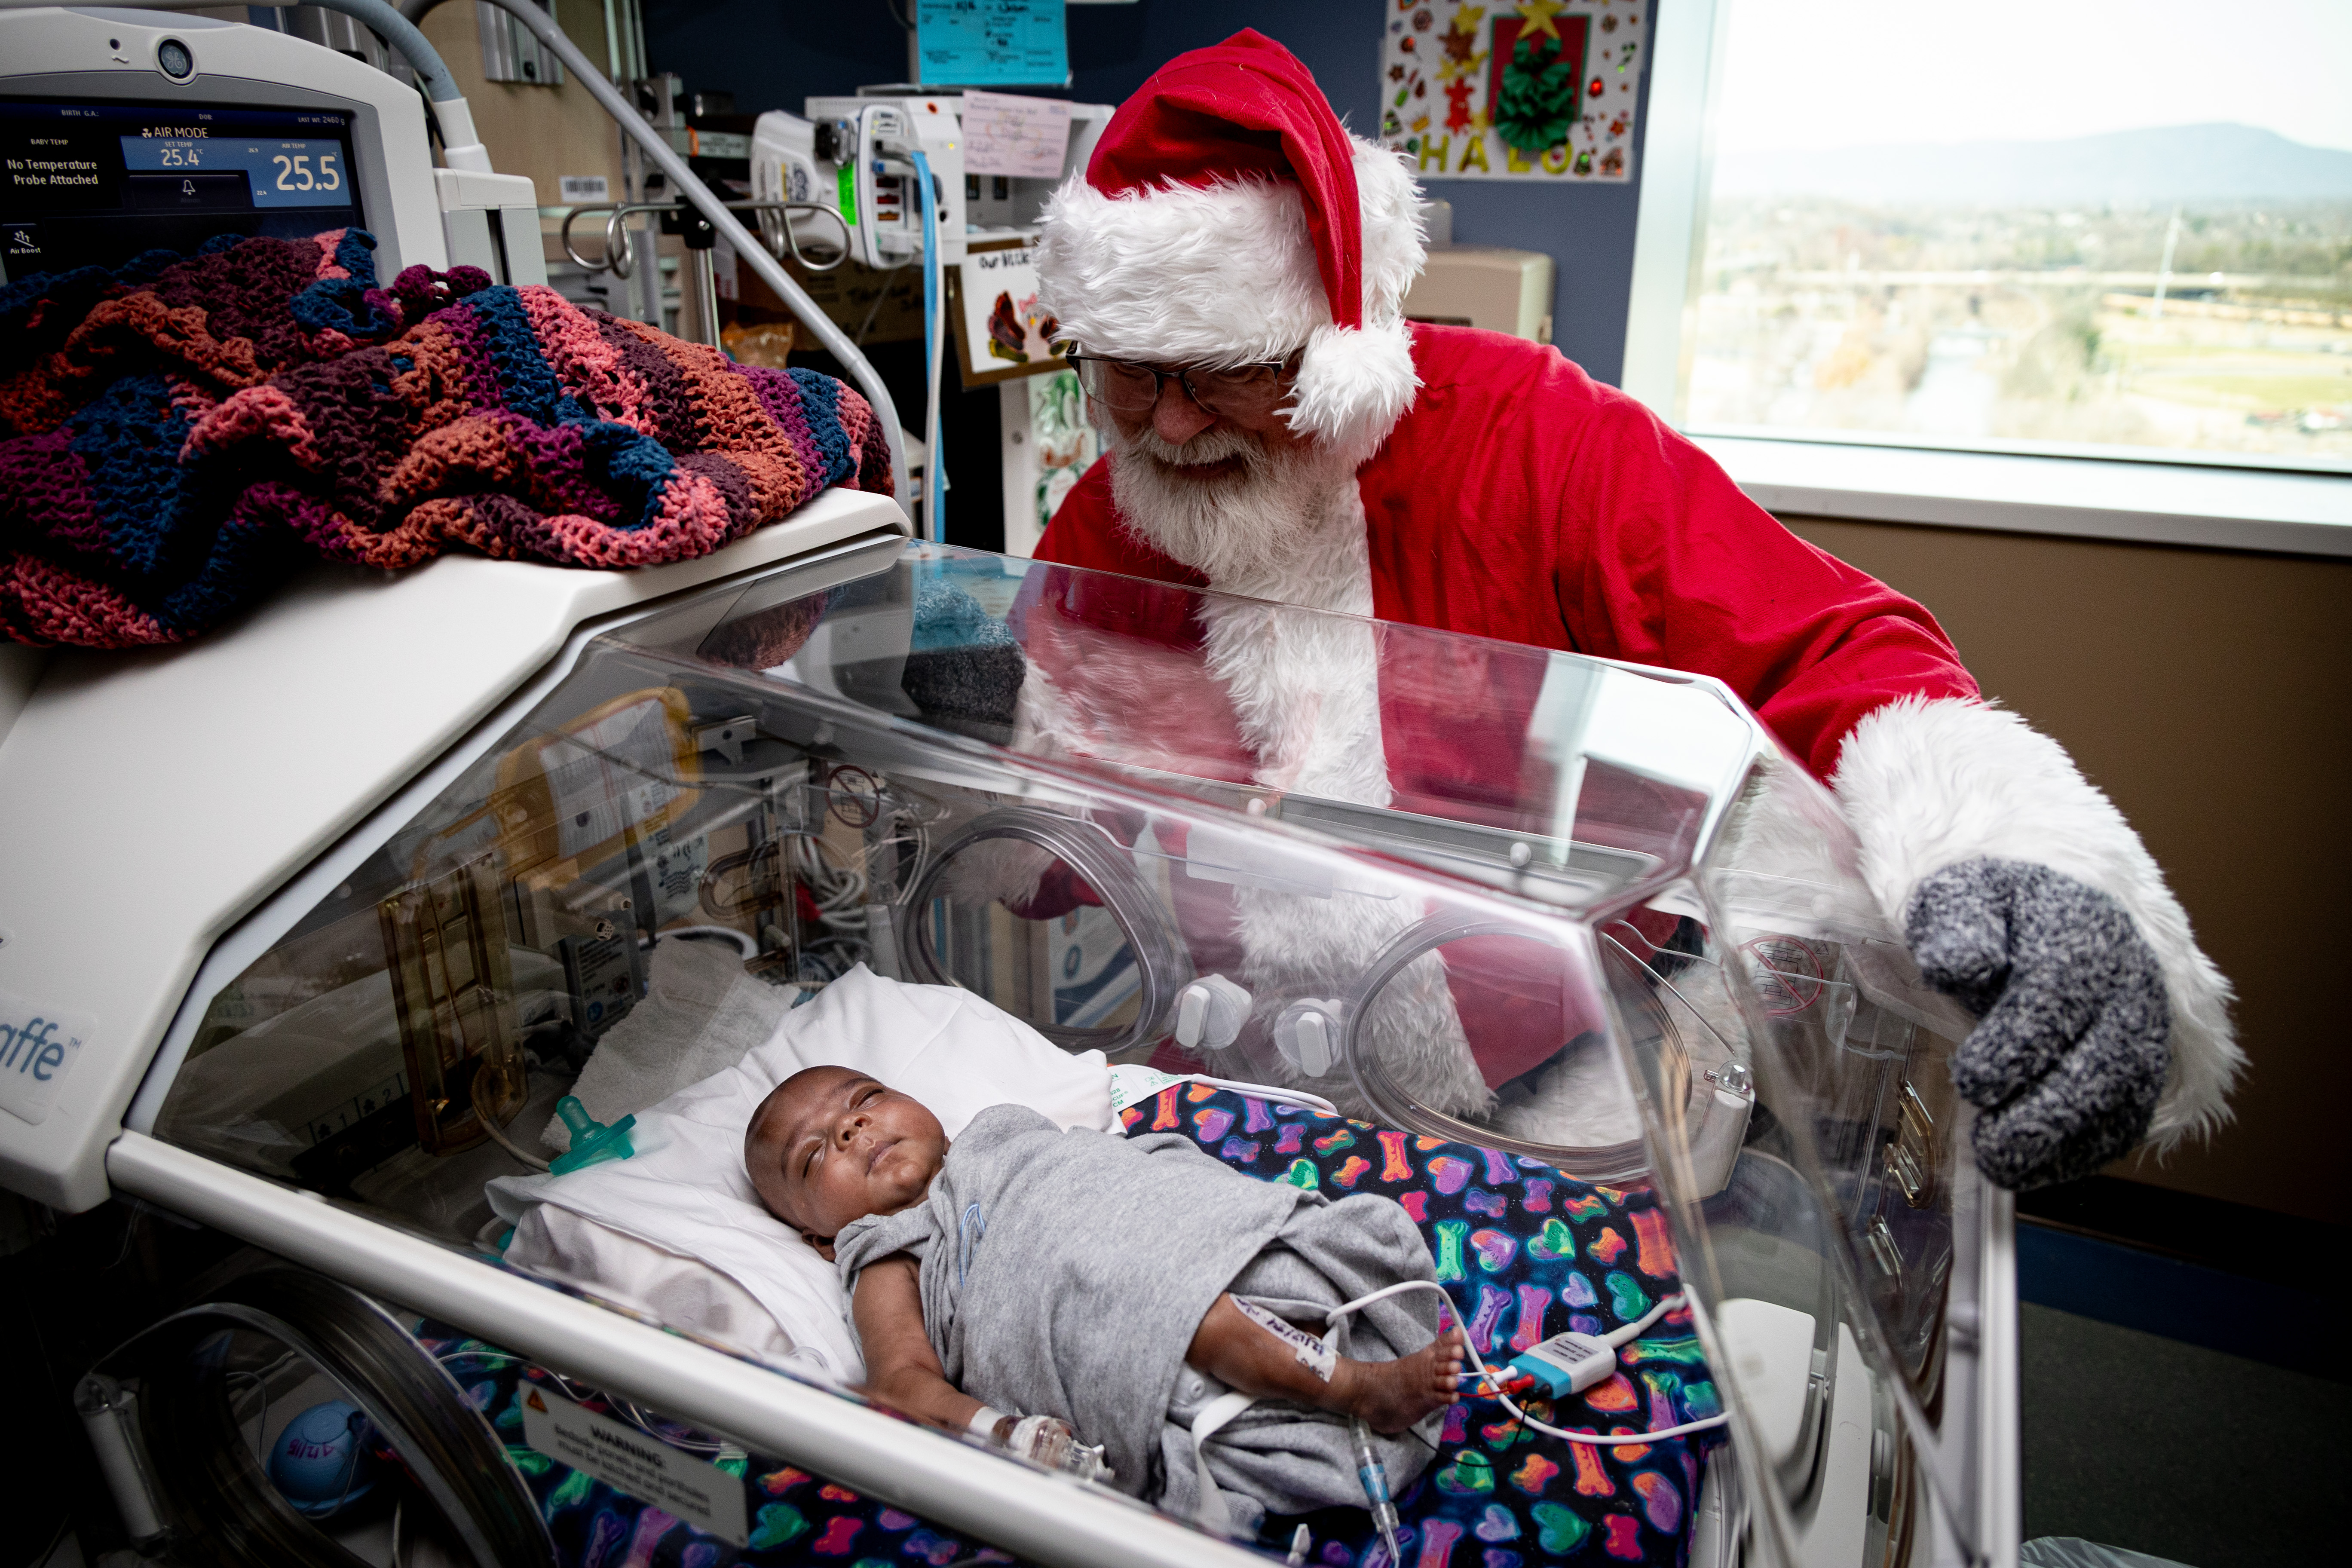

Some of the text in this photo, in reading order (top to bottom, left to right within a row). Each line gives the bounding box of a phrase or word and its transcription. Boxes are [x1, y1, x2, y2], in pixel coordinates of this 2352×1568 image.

[154, 127, 209, 138] AIR MODE
[161, 149, 200, 166] 25.4
[1419, 134, 1573, 174] HALO
[7, 159, 98, 172] No Temperature
[273, 155, 340, 191] 25.5
[14, 174, 98, 185] Probe Attached
[1113, 1099, 1124, 1107] CM
[590, 1425, 665, 1467] WARNING
